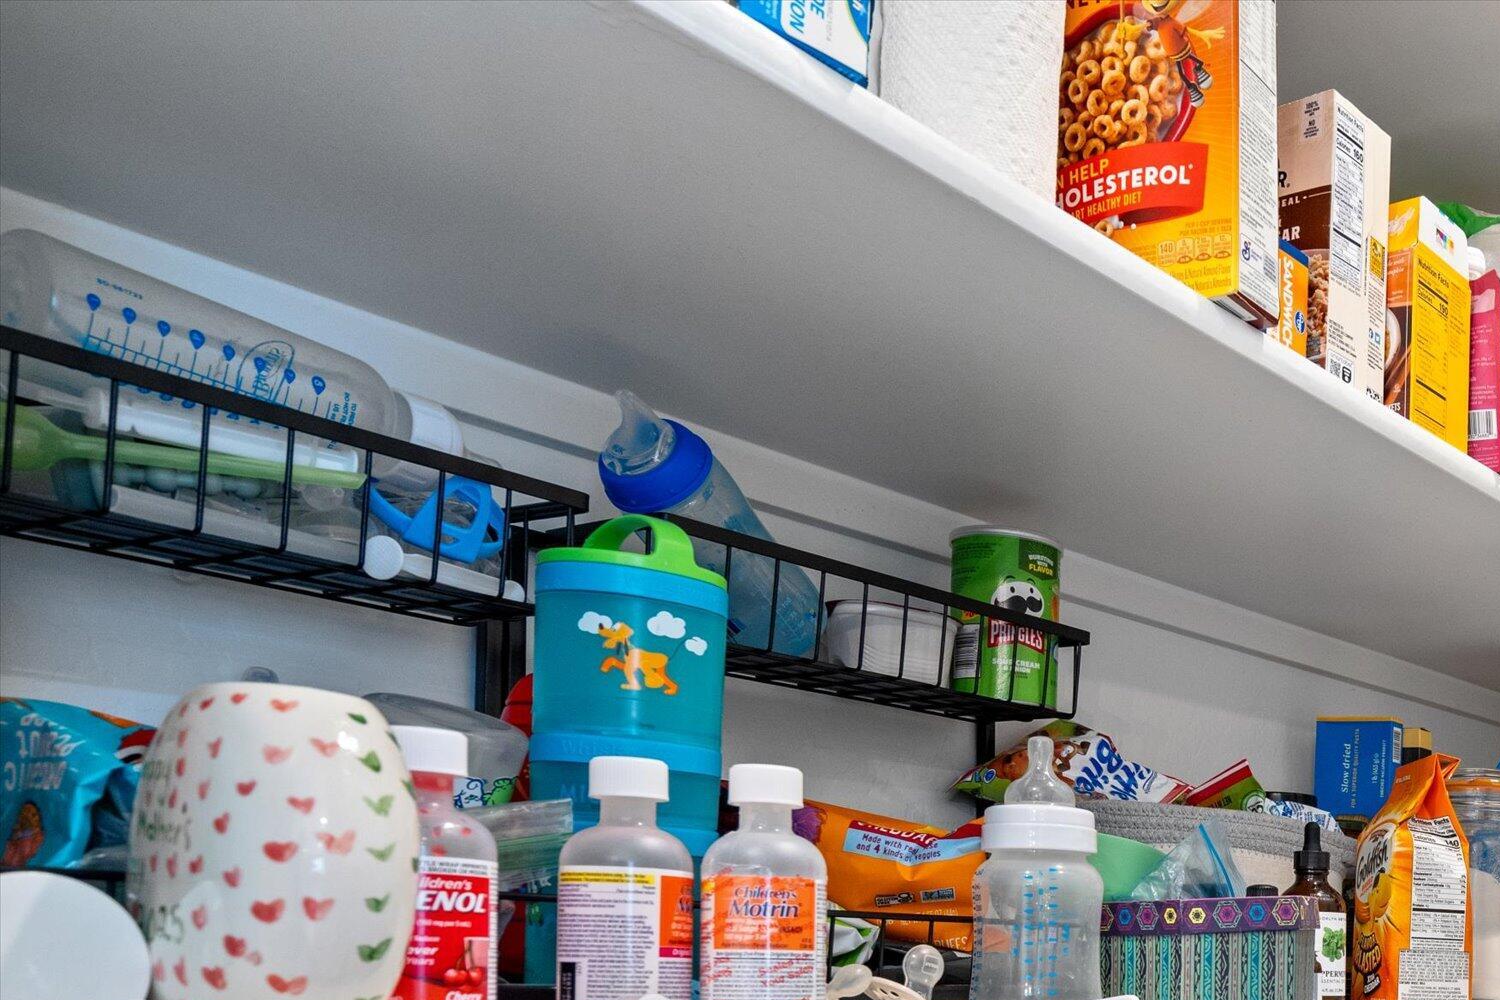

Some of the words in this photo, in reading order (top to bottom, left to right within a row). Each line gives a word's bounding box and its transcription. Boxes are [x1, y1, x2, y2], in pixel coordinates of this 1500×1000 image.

[1069, 158, 1110, 184] HELP
[1087, 194, 1121, 217] HEALTHY
[1123, 191, 1142, 206] DIET
[1028, 563, 1054, 576] FLAVOR
[1343, 743, 1352, 768] dried
[1341, 770, 1349, 793] Slow
[856, 843, 870, 852] and
[874, 844, 880, 853] 4
[883, 848, 903, 859] kinds
[862, 833, 881, 844] Made
[884, 839, 902, 849] with
[1356, 838, 1388, 888] Goldfish
[734, 885, 798, 900] Children's
[729, 900, 802, 919] Motrin
